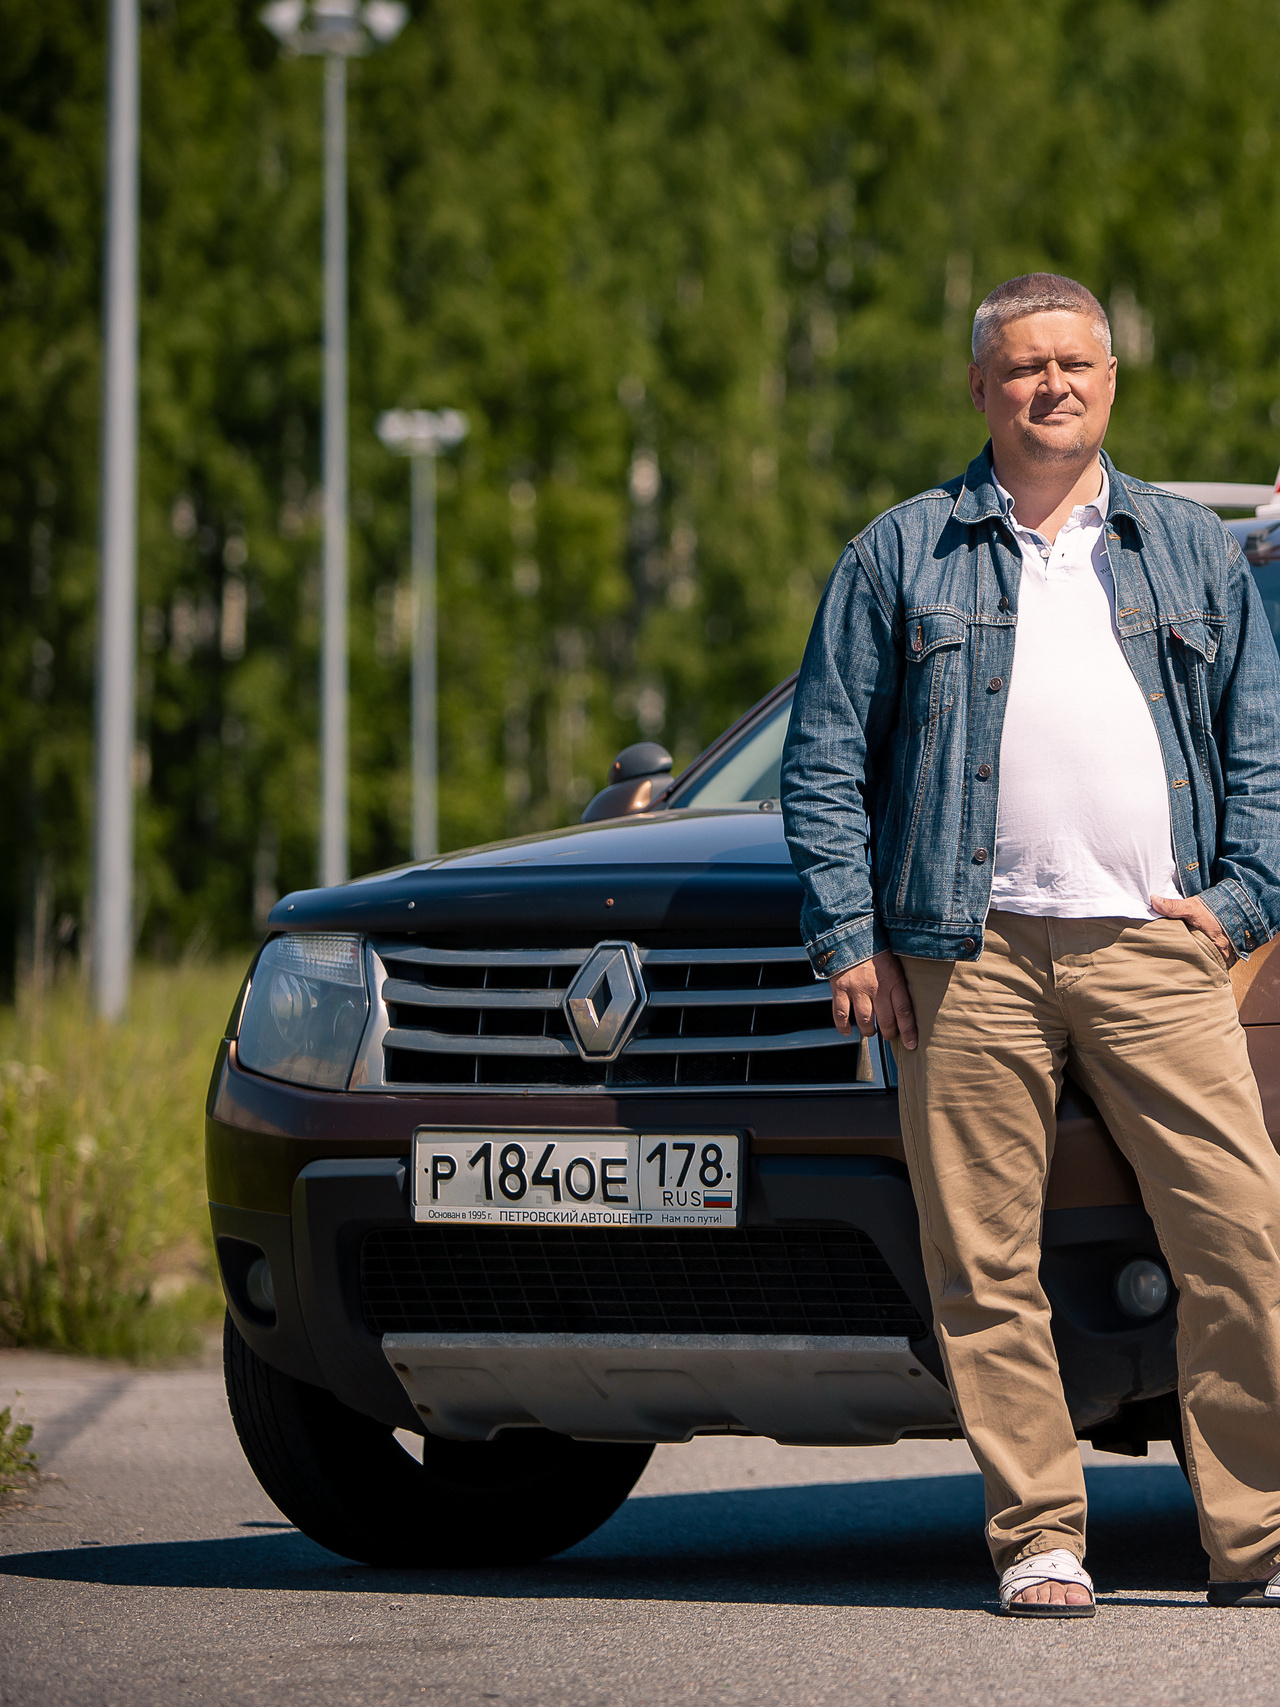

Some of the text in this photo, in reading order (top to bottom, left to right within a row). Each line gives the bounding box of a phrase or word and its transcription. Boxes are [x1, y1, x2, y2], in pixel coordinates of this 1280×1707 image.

[646, 1143, 723, 1188] 178
[663, 1191, 701, 1206] RUS
[428, 1209, 460, 1219] Основан
[468, 1210, 486, 1219] 1995
[500, 1210, 578, 1222] ПЕТРОВСКИЙ
[581, 1212, 653, 1224] АВТОЦЕНТР
[661, 1214, 681, 1223] Нам
[697, 1215, 722, 1225] пути!
